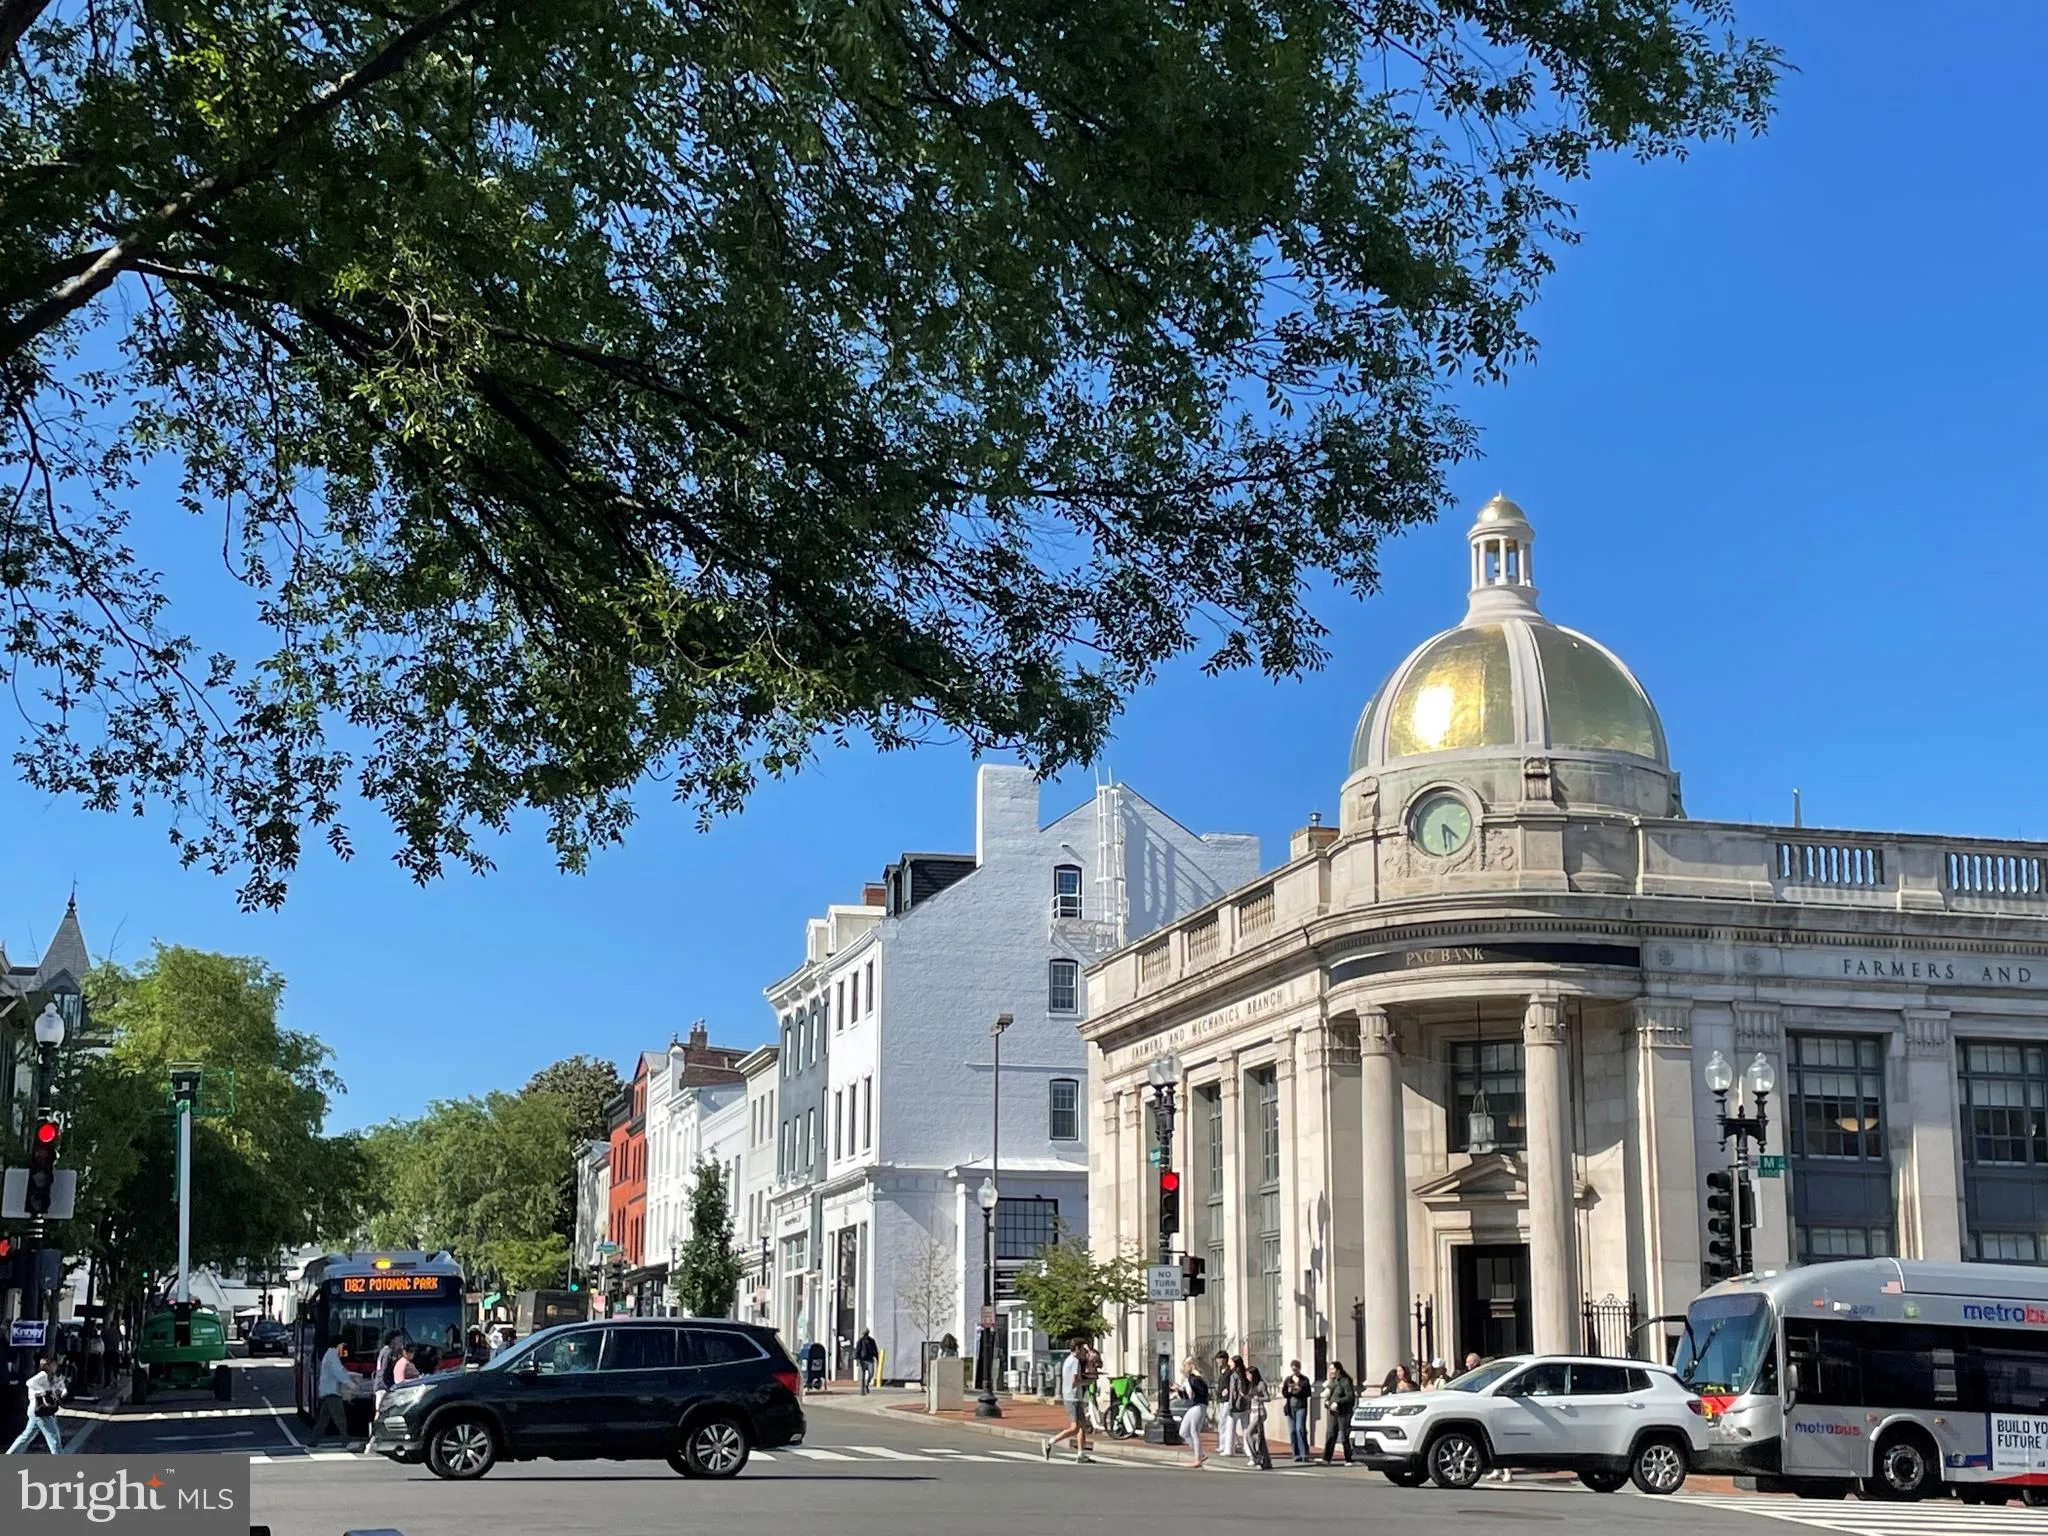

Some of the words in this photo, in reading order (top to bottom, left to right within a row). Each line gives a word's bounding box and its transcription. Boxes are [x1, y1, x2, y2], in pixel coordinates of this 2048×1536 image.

[1406, 951, 1434, 966] PNC
[1441, 947, 1484, 962] BANK
[1843, 959, 1954, 979] FARMERS
[1982, 966, 2032, 983] AND
[1132, 1036, 1163, 1061] FARMERS
[1169, 1028, 1185, 1045] AND
[1192, 1006, 1240, 1037] MECHANICS
[1247, 989, 1283, 1015] BRANCH
[1763, 1157, 1775, 1168] M
[344, 1279, 365, 1292] D82
[369, 1277, 411, 1291] POTOMAC
[413, 1276, 438, 1290] PARK
[1795, 1421, 1861, 1436] metrobus
[1997, 1420, 2030, 1434] BUILD
[2034, 1421, 2048, 1434] YO
[1997, 1434, 2042, 1449] FUTURE
